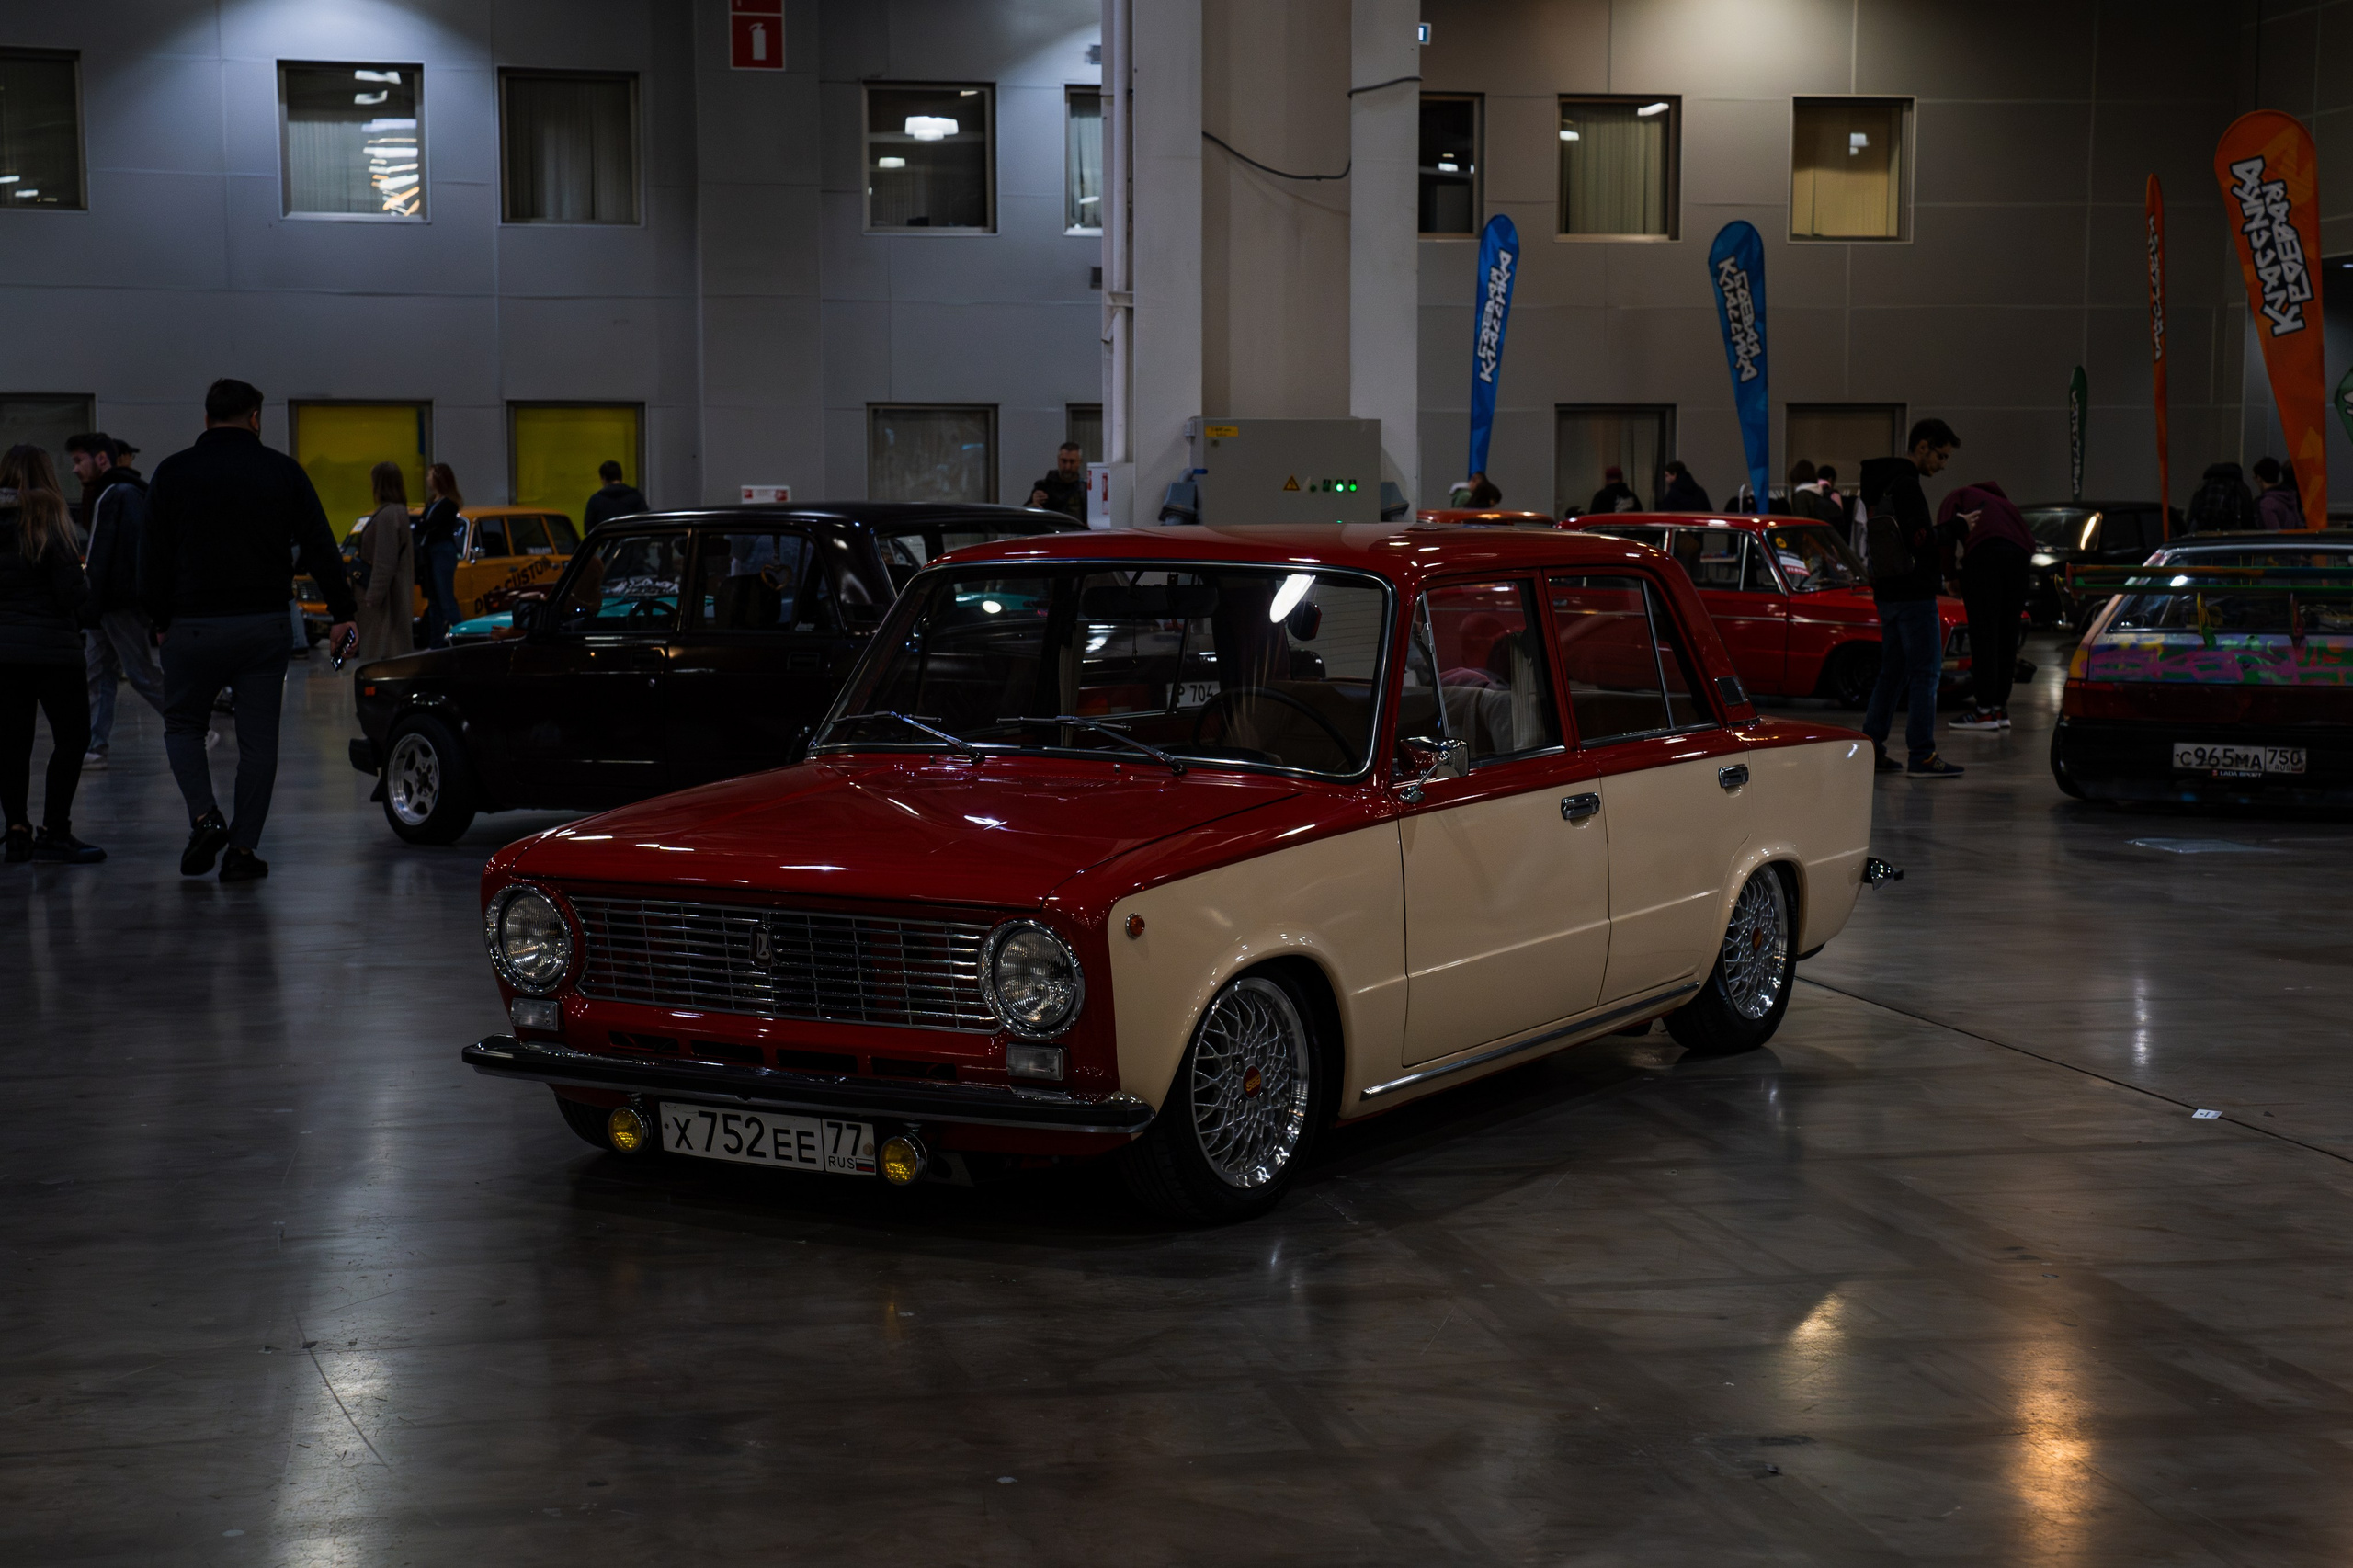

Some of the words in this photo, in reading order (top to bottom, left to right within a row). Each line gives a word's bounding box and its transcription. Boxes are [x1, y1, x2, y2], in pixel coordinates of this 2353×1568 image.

[2180, 747, 2262, 770] C965MA
[673, 1110, 817, 1164] X752EE
[827, 1121, 862, 1156] 77
[828, 1155, 855, 1169] RUS
